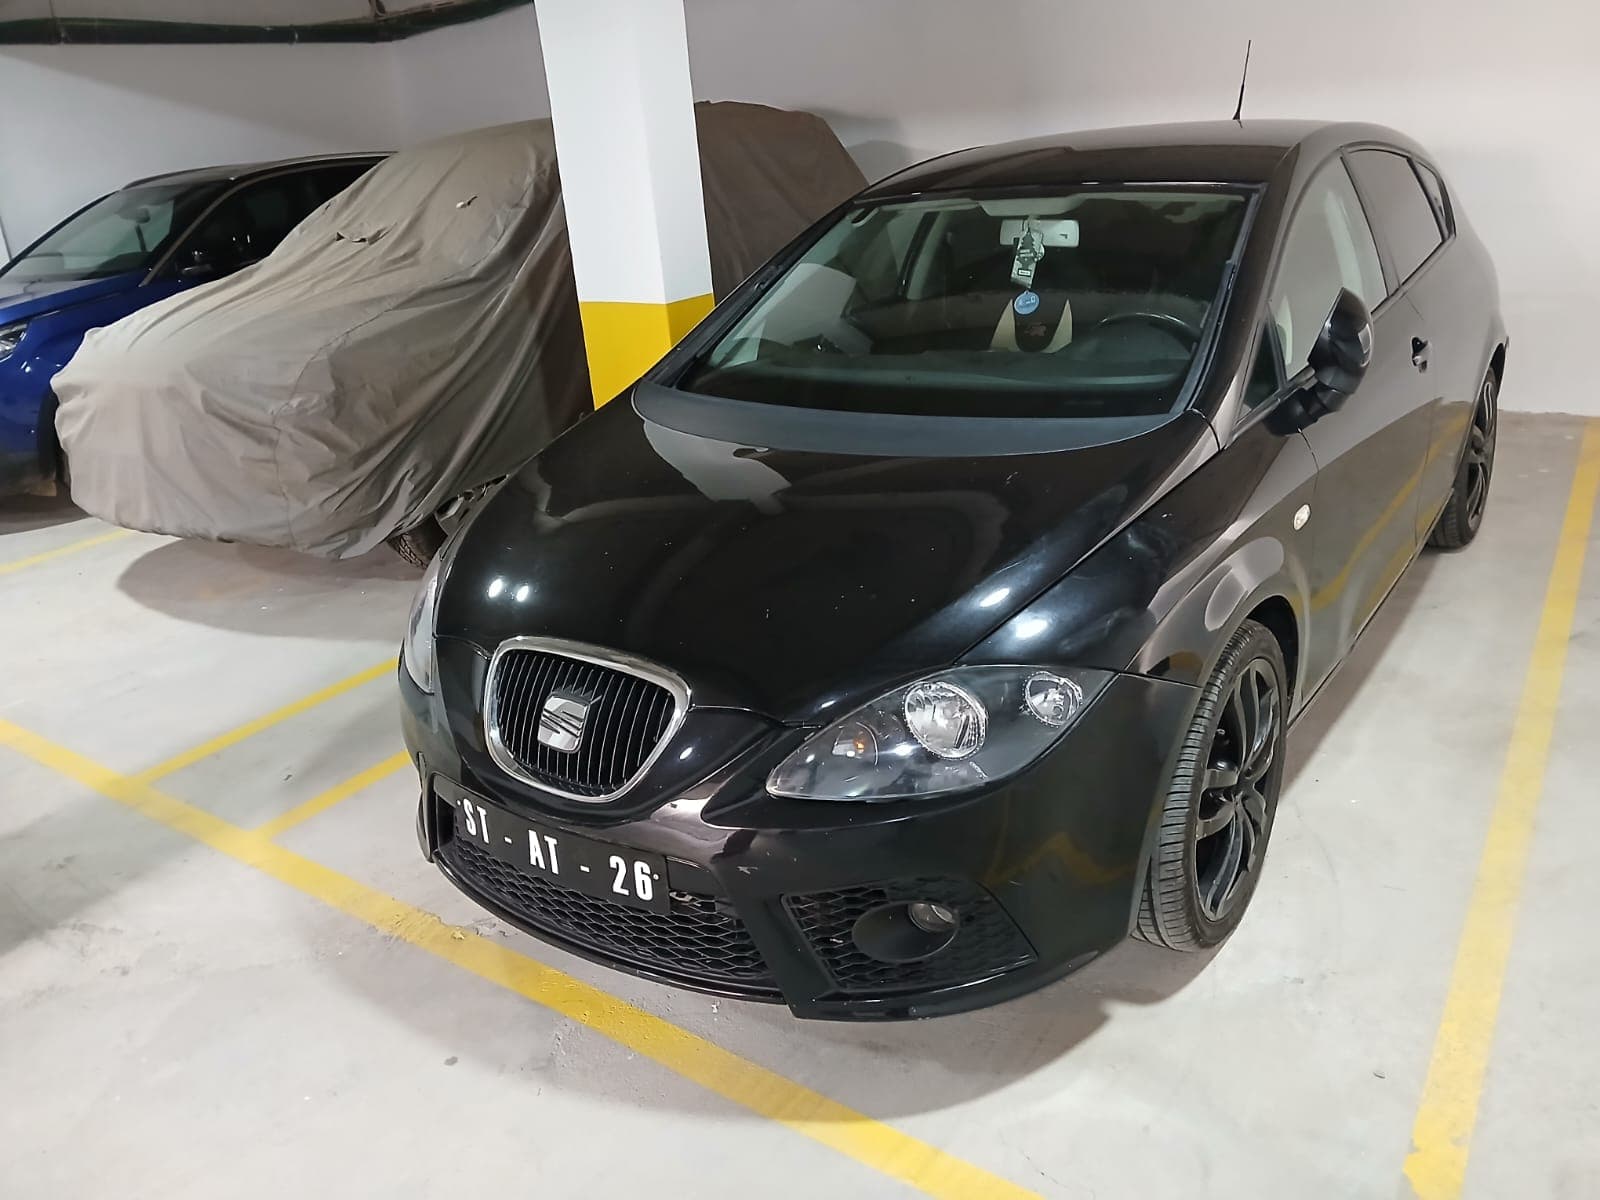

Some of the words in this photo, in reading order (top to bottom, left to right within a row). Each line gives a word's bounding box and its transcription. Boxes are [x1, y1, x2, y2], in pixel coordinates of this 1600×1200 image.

[463, 798, 490, 844] ST
[528, 829, 560, 875] AT
[609, 855, 653, 901] 26
